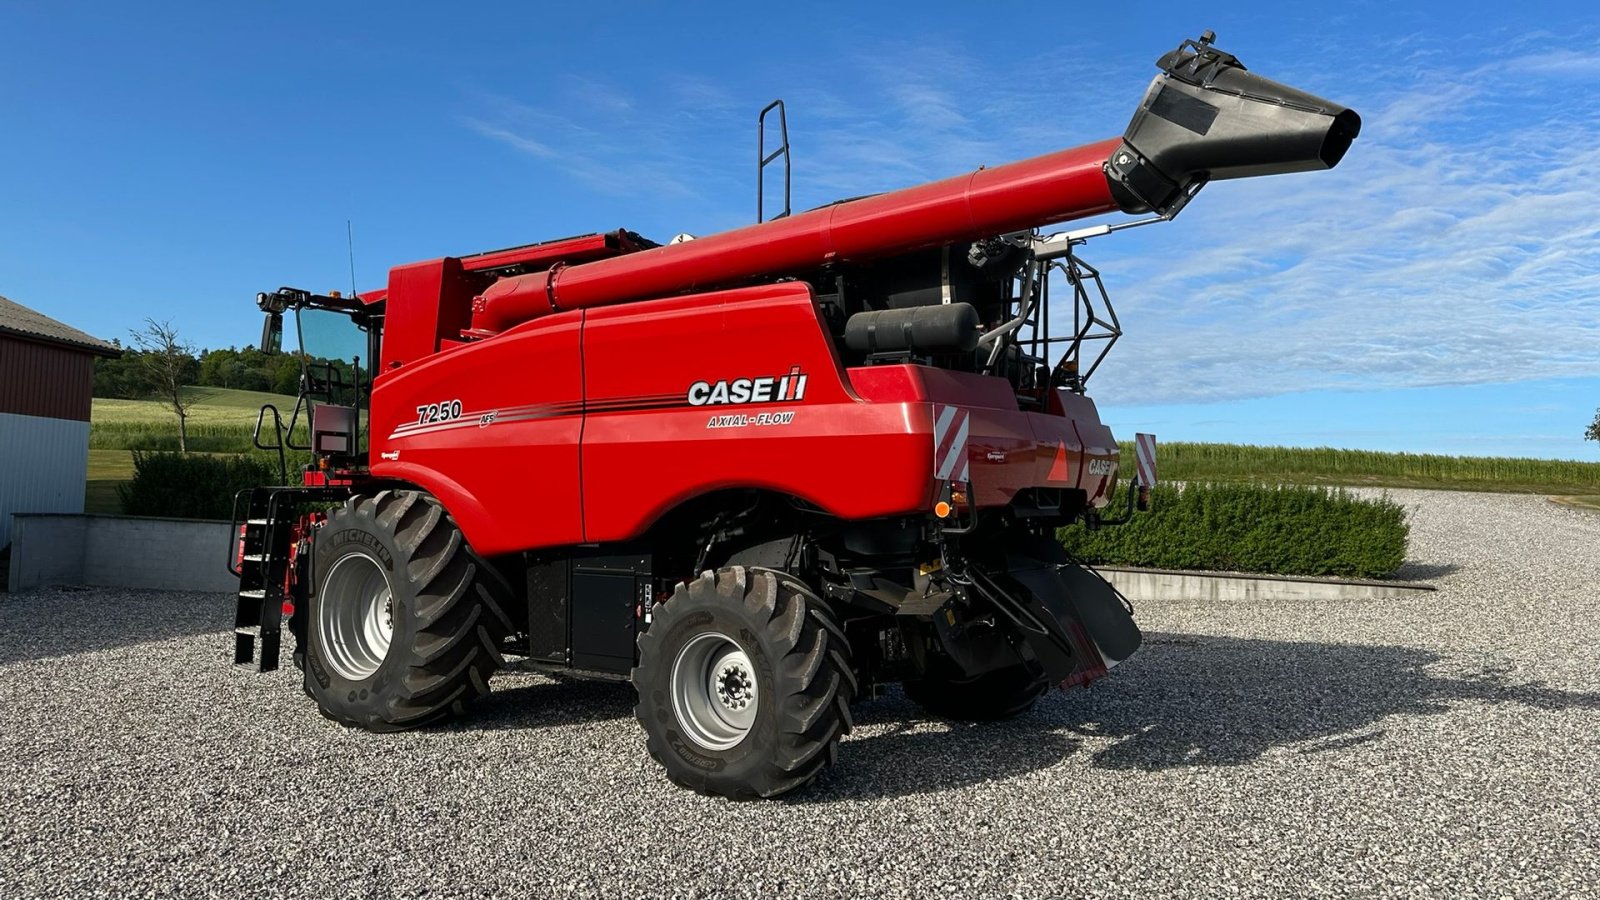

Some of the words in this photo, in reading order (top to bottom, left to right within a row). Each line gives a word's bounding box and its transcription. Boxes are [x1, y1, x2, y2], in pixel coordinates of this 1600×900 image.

[687, 377, 775, 406] CASE
[417, 399, 462, 425] 7250
[1088, 459, 1110, 476] CASE
[333, 529, 391, 562] MICHELIN
